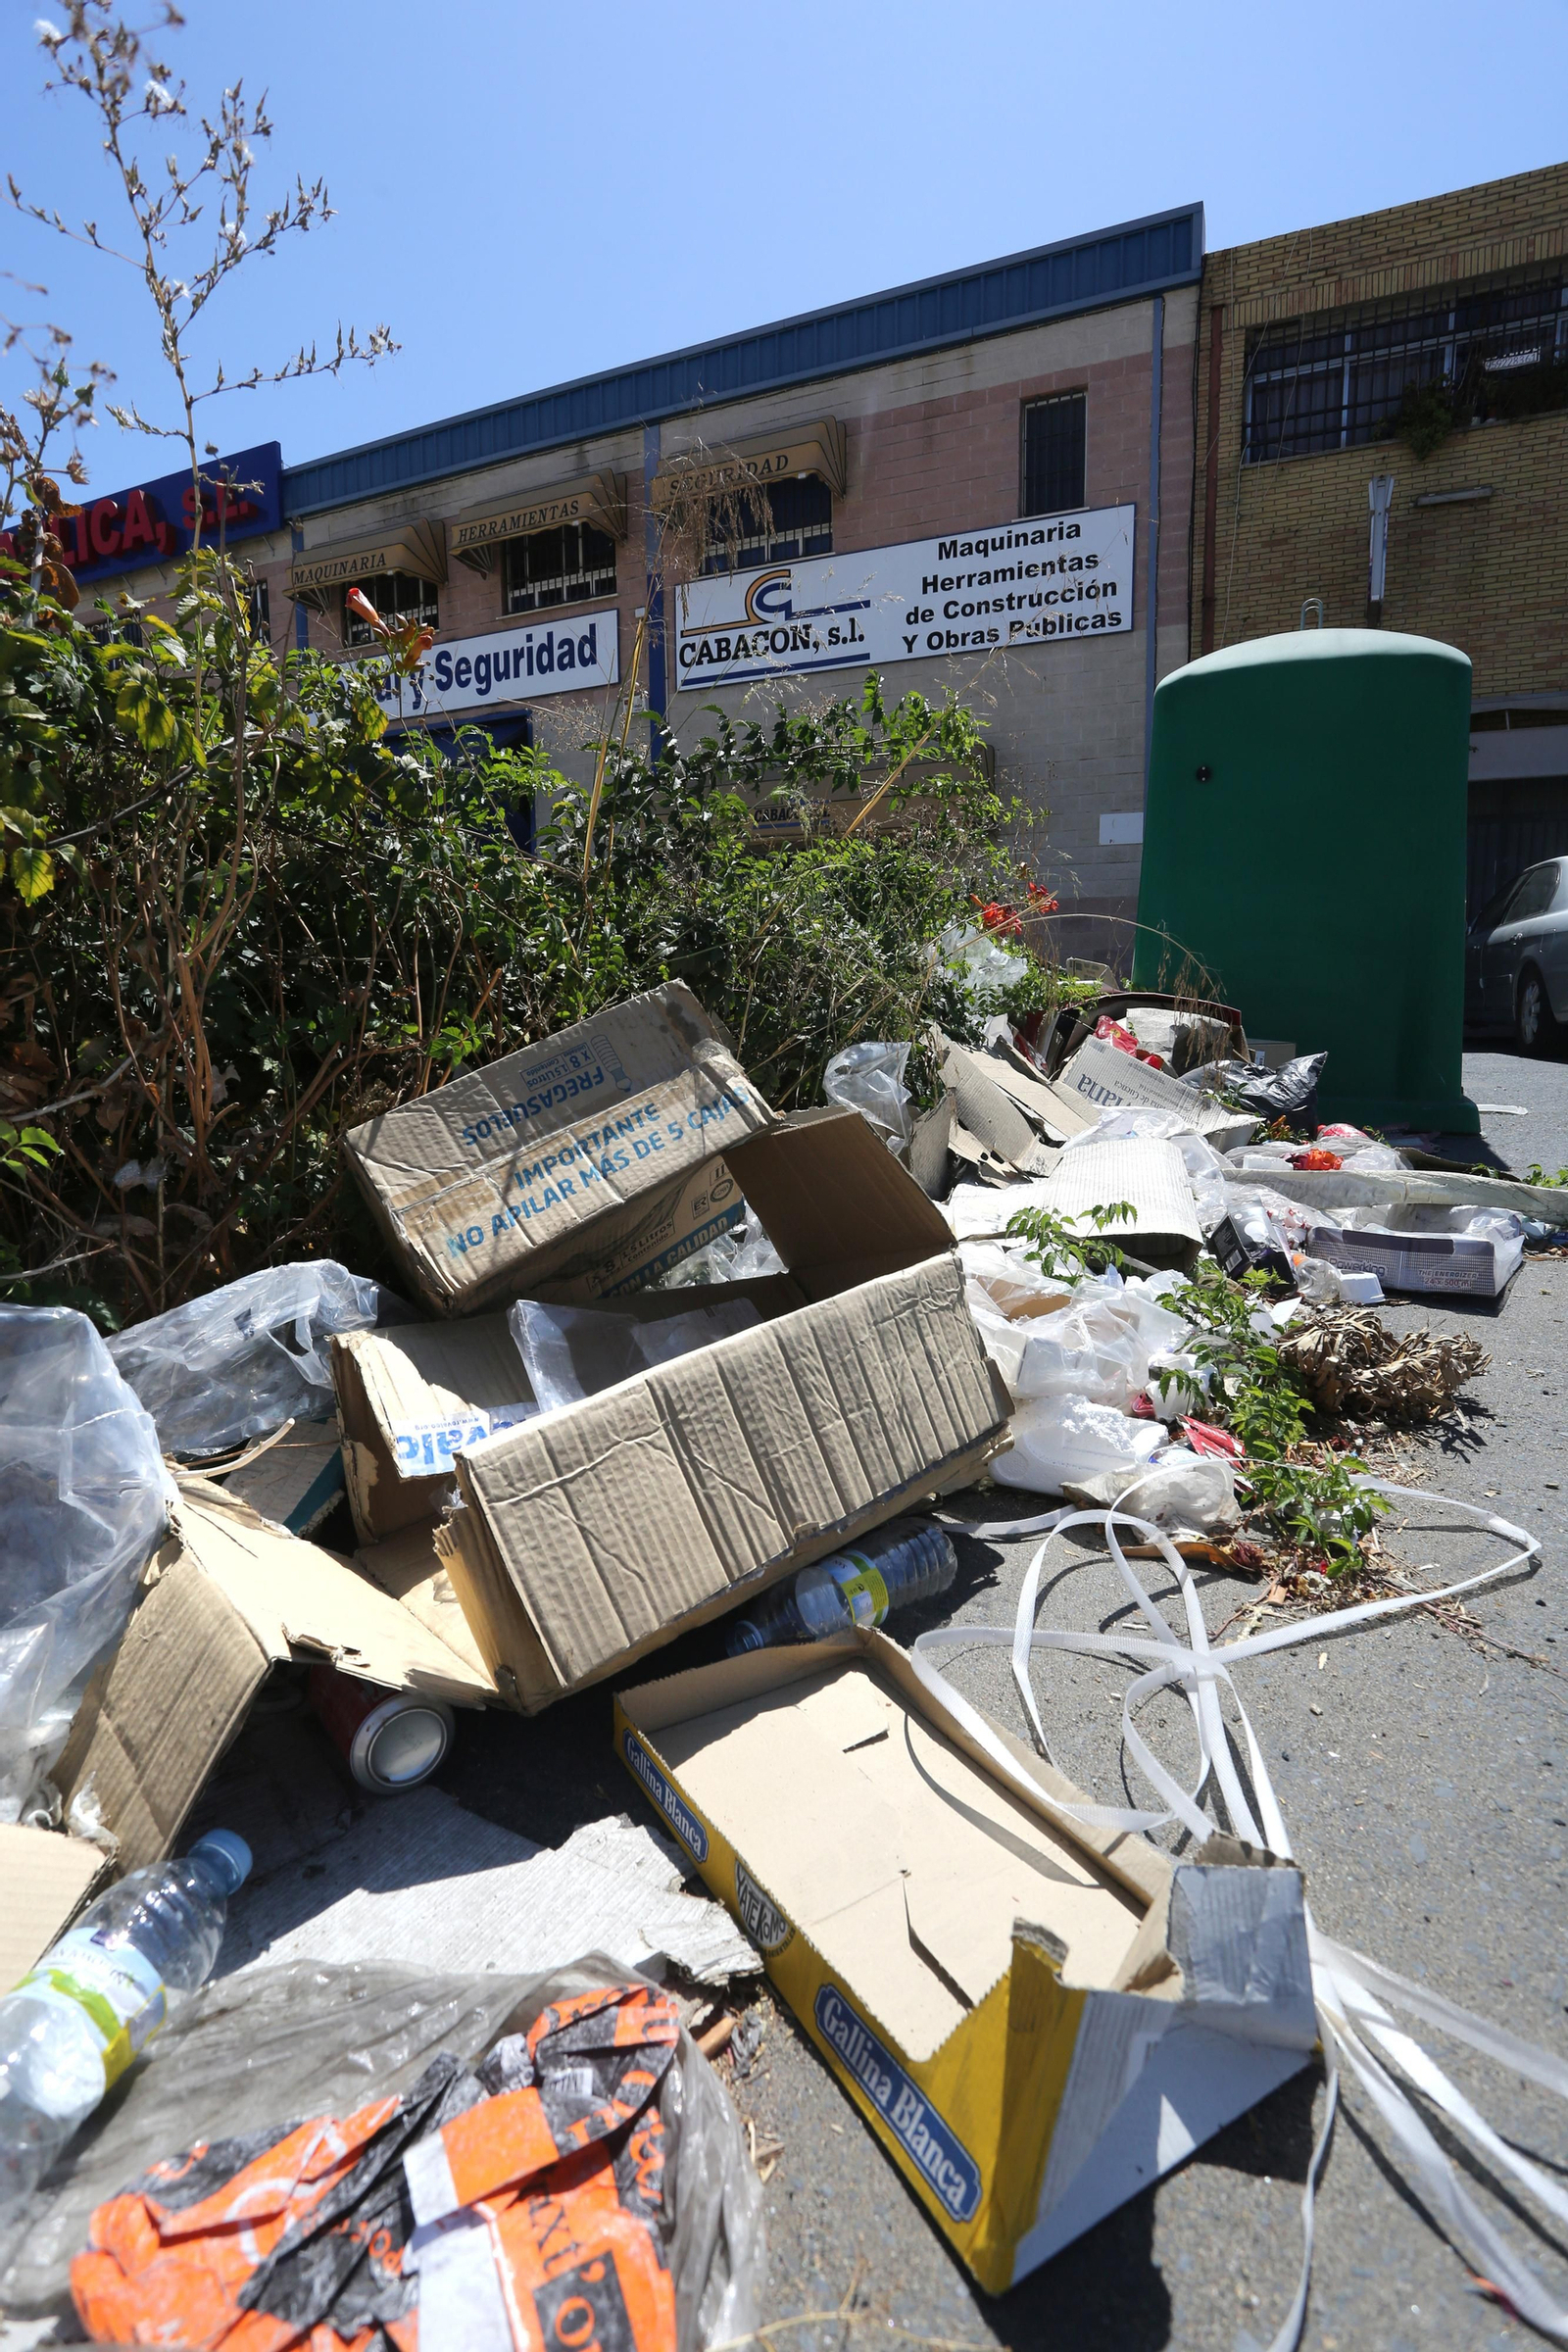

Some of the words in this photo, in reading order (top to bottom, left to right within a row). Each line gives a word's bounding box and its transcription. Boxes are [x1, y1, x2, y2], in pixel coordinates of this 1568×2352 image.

[457, 500, 579, 544] HERRAMIENTAS
[938, 520, 1081, 561] Maquinaria
[293, 552, 387, 585] MAQUINARIA
[921, 553, 1100, 595] Herramientas
[906, 607, 934, 625] de
[943, 578, 1118, 619] Construcción
[902, 634, 918, 654] Y
[926, 626, 1000, 651] Obras
[1008, 611, 1122, 639] Publicas
[434, 622, 597, 696] Seguridad
[526, 1057, 560, 1076] Contenido
[526, 1068, 557, 1088] Litros
[462, 1064, 606, 1147] FREGASUELOS
[1113, 1079, 1139, 1101] Cuenca
[513, 1102, 661, 1191] IMPORTANTE
[446, 1223, 483, 1259] NO
[490, 1178, 578, 1238] APILAR
[580, 1150, 631, 1188] MÁS
[632, 1128, 665, 1160] DE
[667, 1120, 684, 1142] 5
[685, 1085, 751, 1134] CAJAS
[627, 1232, 668, 1263] Contenido
[638, 1219, 673, 1247] Litros
[666, 1216, 728, 1266] CALIDAD
[623, 1733, 663, 1801] Gallina
[663, 1790, 704, 1857] Blanca
[822, 1995, 894, 2108] Gallina
[890, 2093, 966, 2215] Blanca
